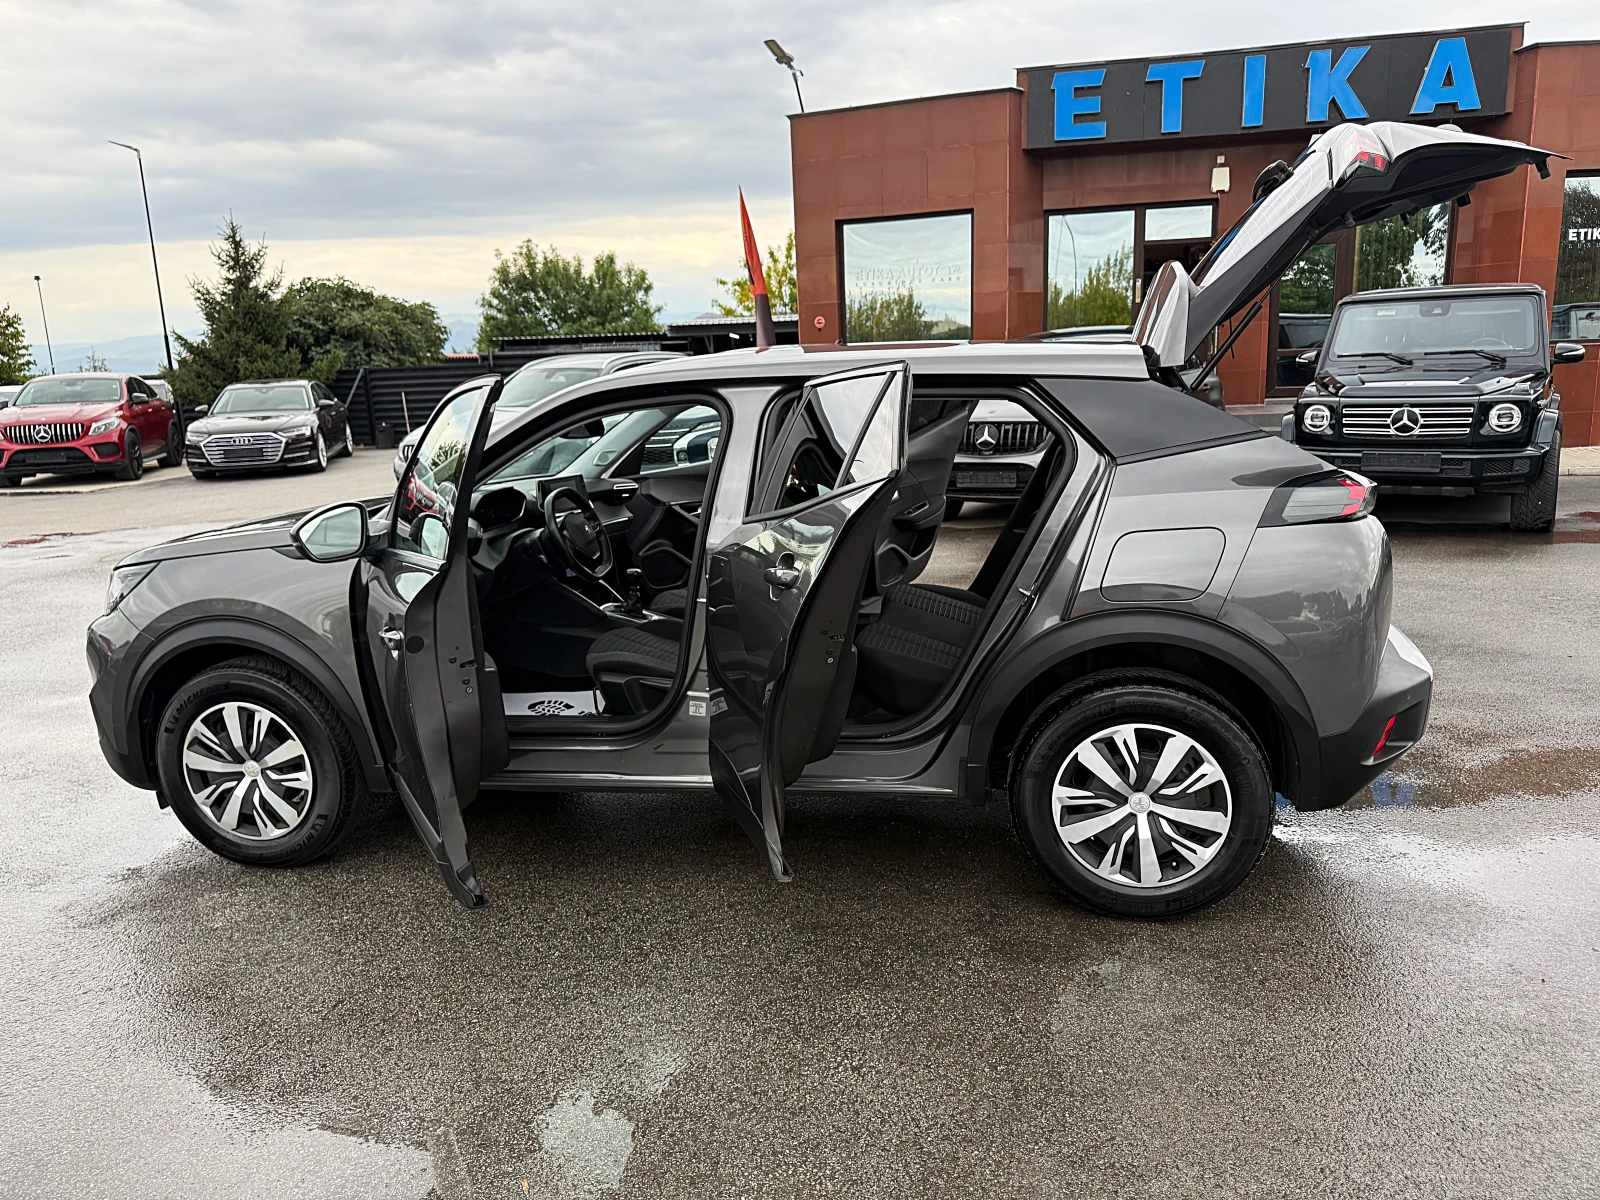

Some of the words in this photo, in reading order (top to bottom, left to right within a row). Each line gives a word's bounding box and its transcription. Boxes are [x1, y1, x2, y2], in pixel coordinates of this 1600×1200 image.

[1051, 37, 1481, 141] ETIKA
[855, 268, 894, 281] ETIKA
[175, 682, 227, 716] MICHE
